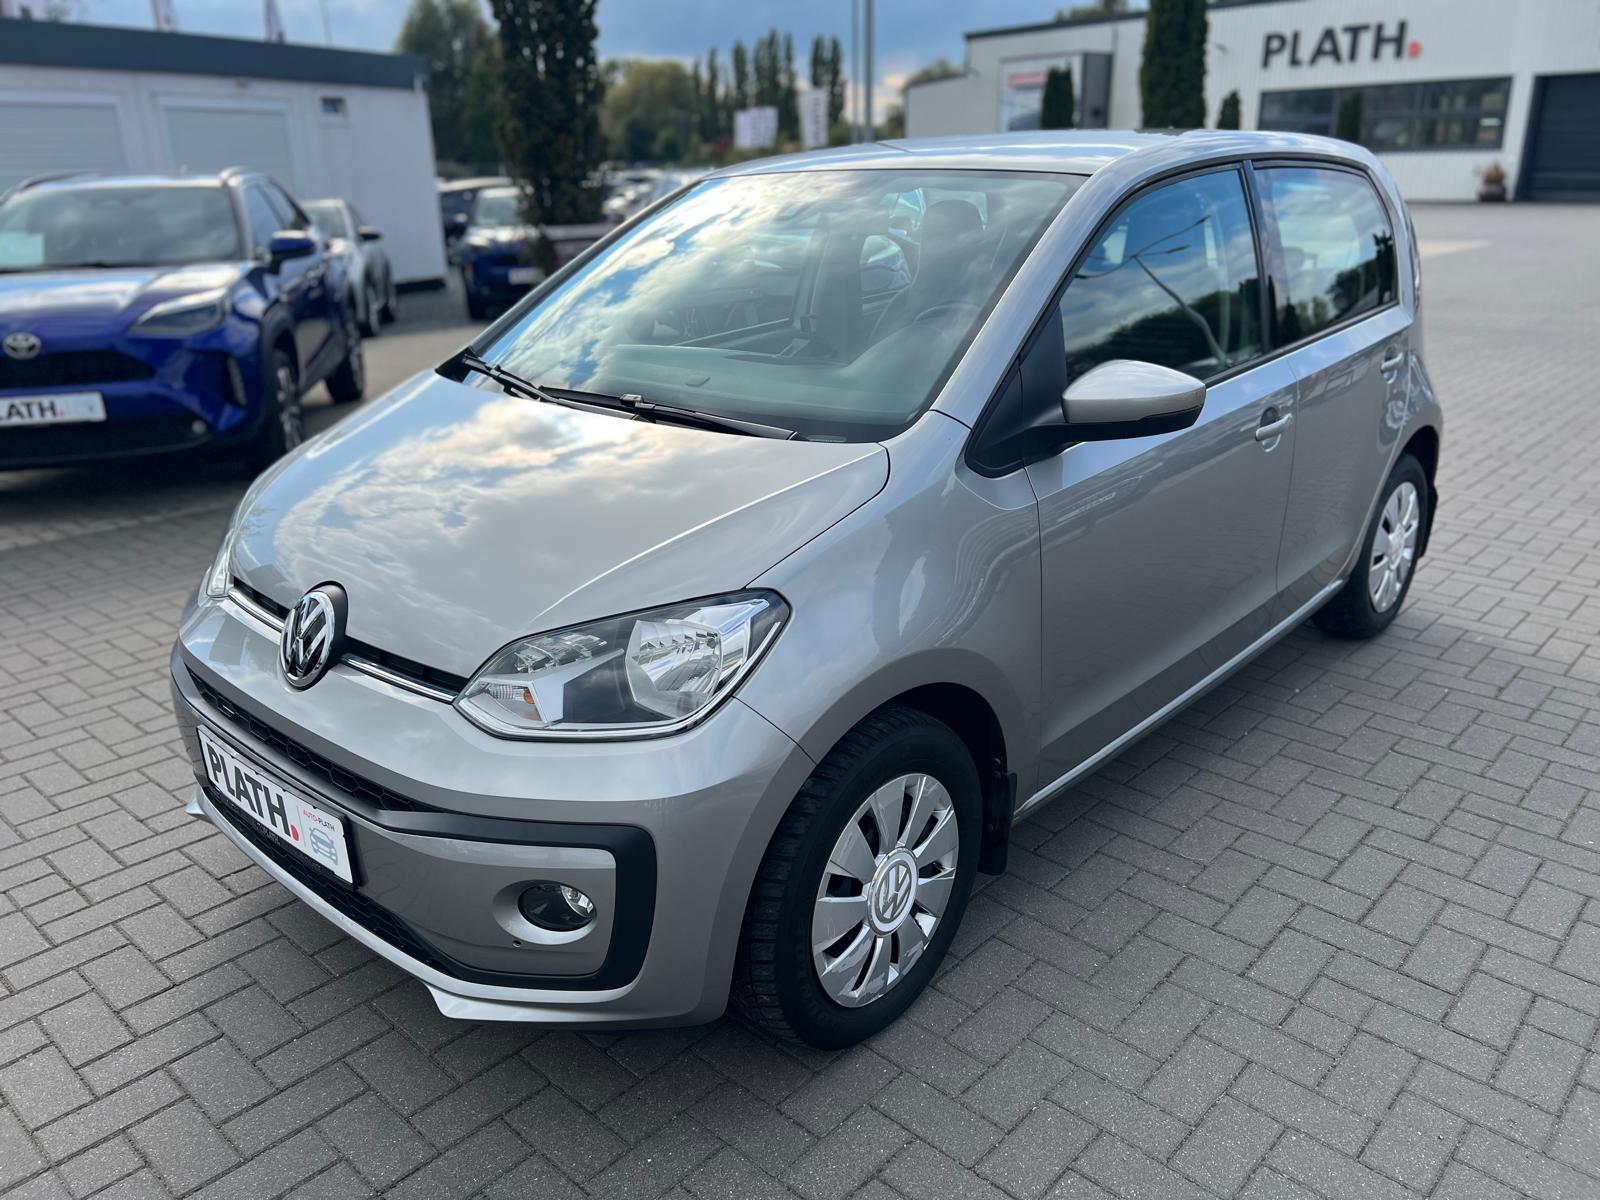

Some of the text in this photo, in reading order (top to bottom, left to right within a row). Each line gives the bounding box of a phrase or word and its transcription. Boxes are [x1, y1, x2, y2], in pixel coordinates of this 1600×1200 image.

[1262, 20, 1422, 69] PLATH.
[0, 400, 65, 419] ATH.
[206, 743, 299, 841] PLATH.
